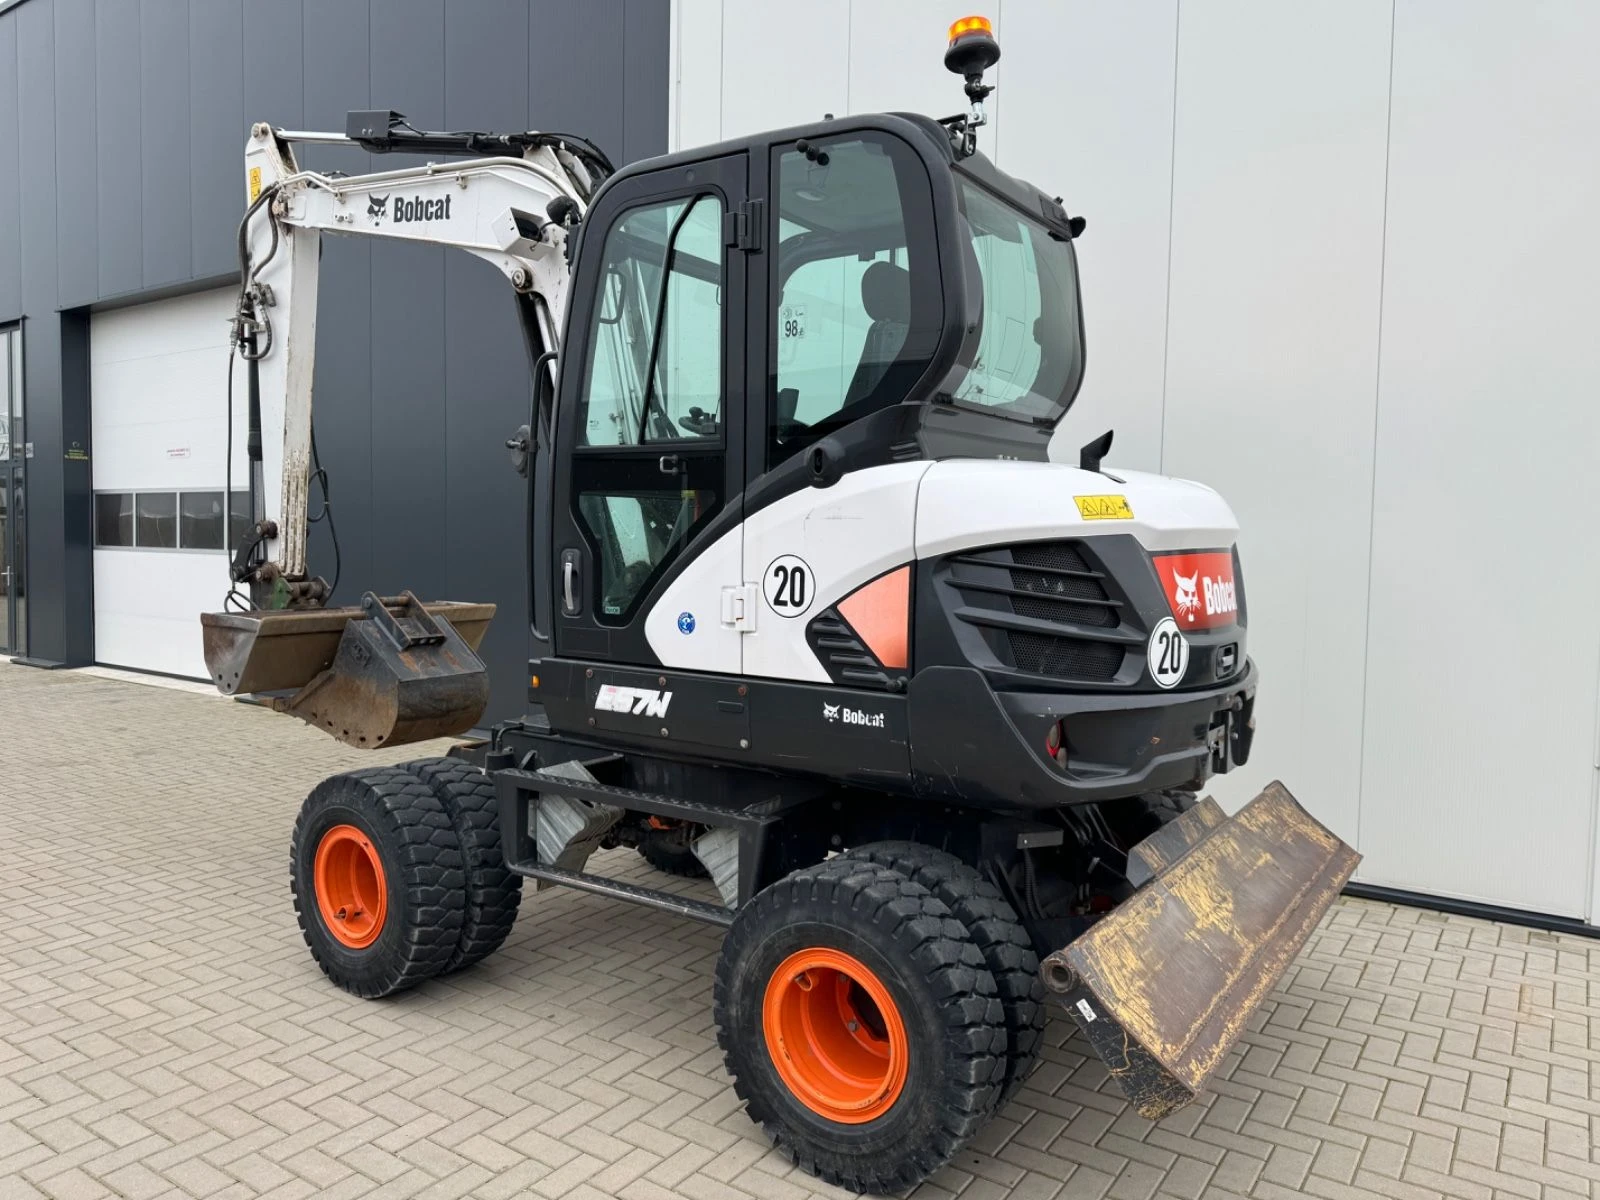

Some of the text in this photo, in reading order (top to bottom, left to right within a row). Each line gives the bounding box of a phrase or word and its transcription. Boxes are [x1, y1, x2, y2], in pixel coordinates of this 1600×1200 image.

[394, 194, 451, 222] Bobcat
[785, 320, 798, 337] 98
[774, 565, 805, 607] 20
[1157, 631, 1181, 674] 20
